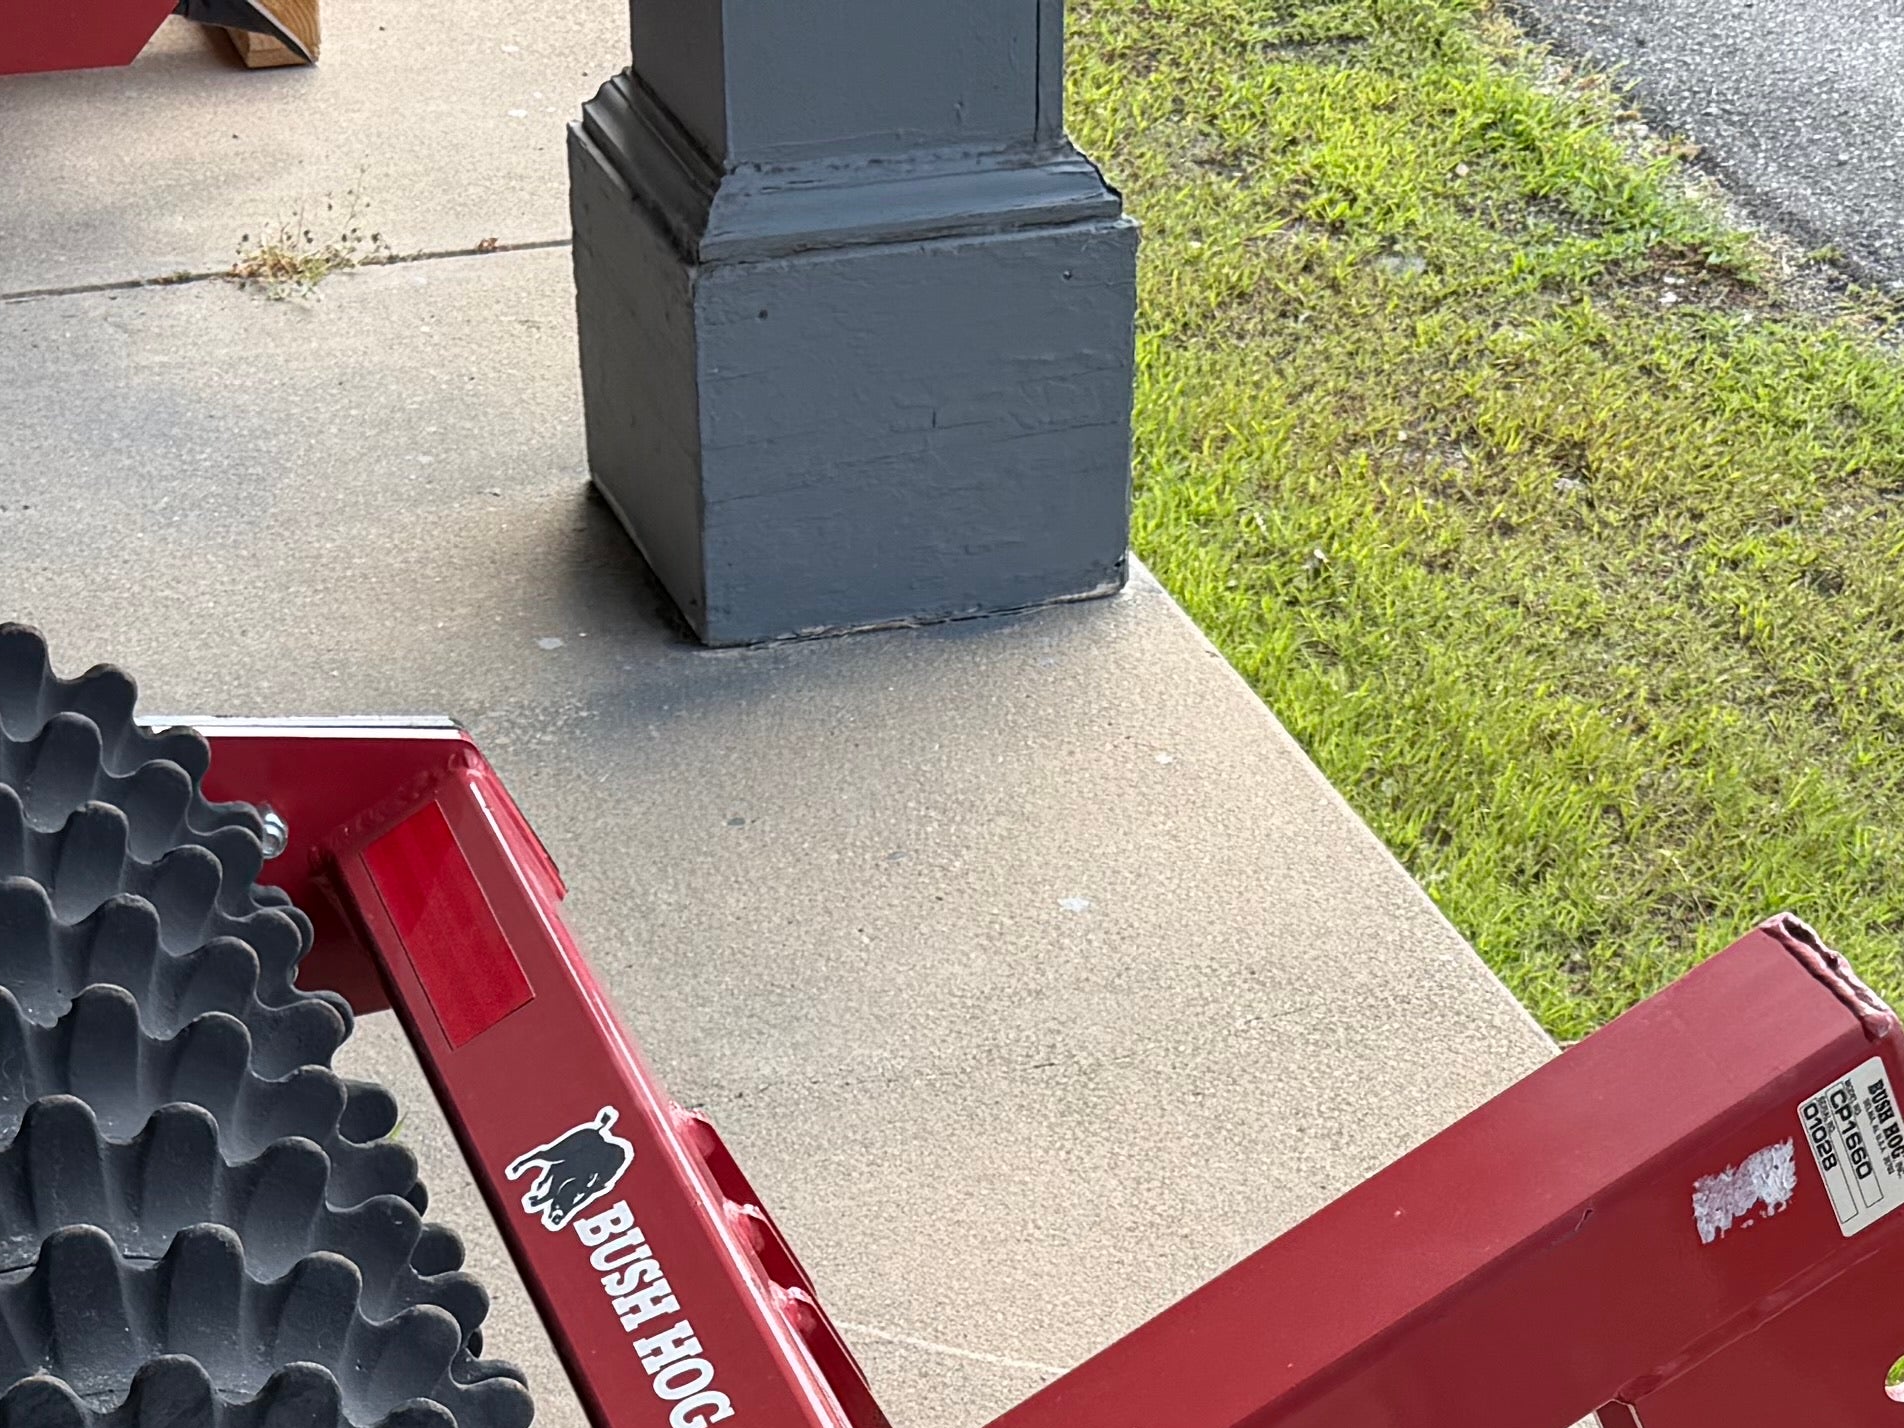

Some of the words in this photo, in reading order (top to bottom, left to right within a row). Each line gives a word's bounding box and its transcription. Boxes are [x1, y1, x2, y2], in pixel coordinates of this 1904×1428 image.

[1803, 1103, 1837, 1171] 01028
[1830, 1090, 1872, 1179] CP1660
[1867, 1079, 1895, 1124] BUSH
[573, 1200, 681, 1332] BUSH
